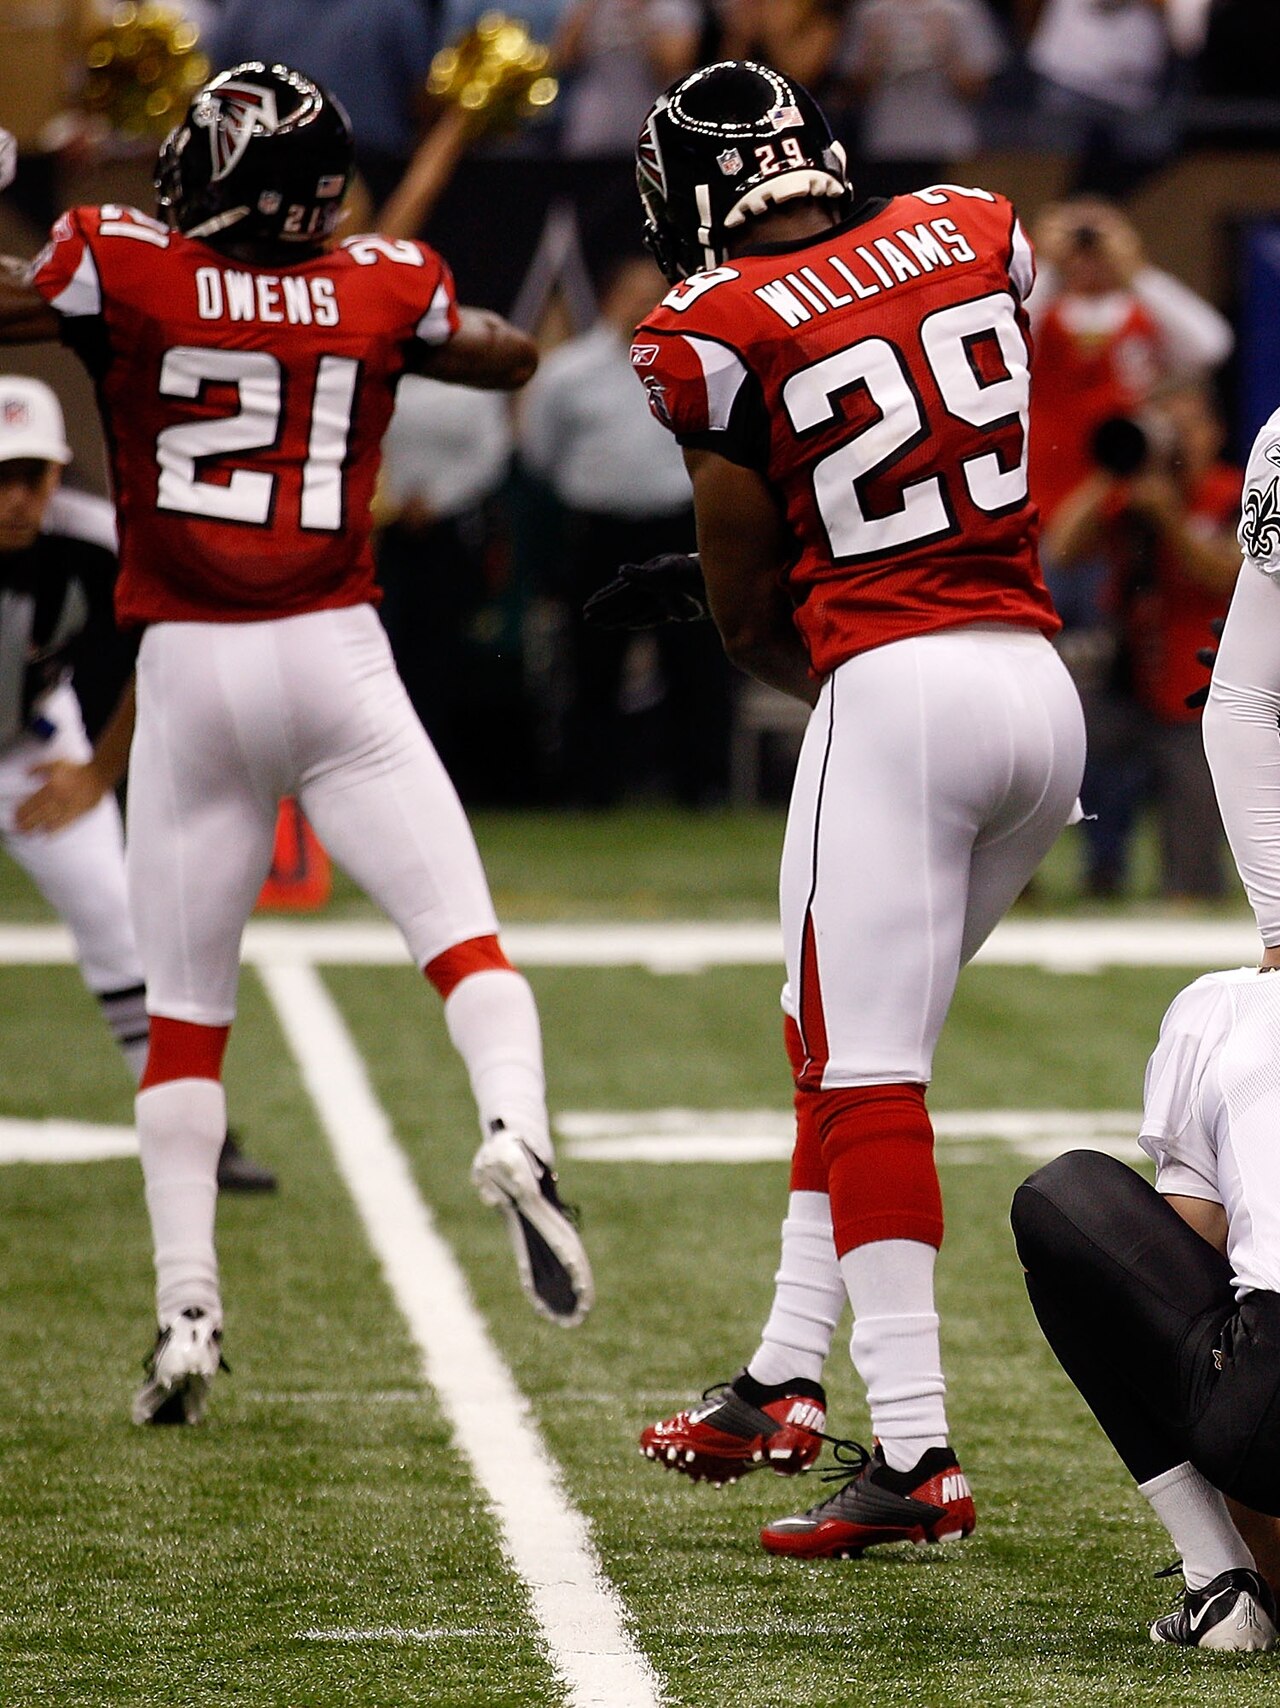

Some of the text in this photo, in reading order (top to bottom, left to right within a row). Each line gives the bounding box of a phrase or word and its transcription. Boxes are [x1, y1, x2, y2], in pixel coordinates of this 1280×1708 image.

[754, 138, 804, 175] 29
[283, 203, 321, 234] 21
[196, 266, 340, 327] OWENS
[754, 217, 977, 329] WILLIAMS
[156, 346, 362, 532] 21
[783, 292, 1032, 559] 29
